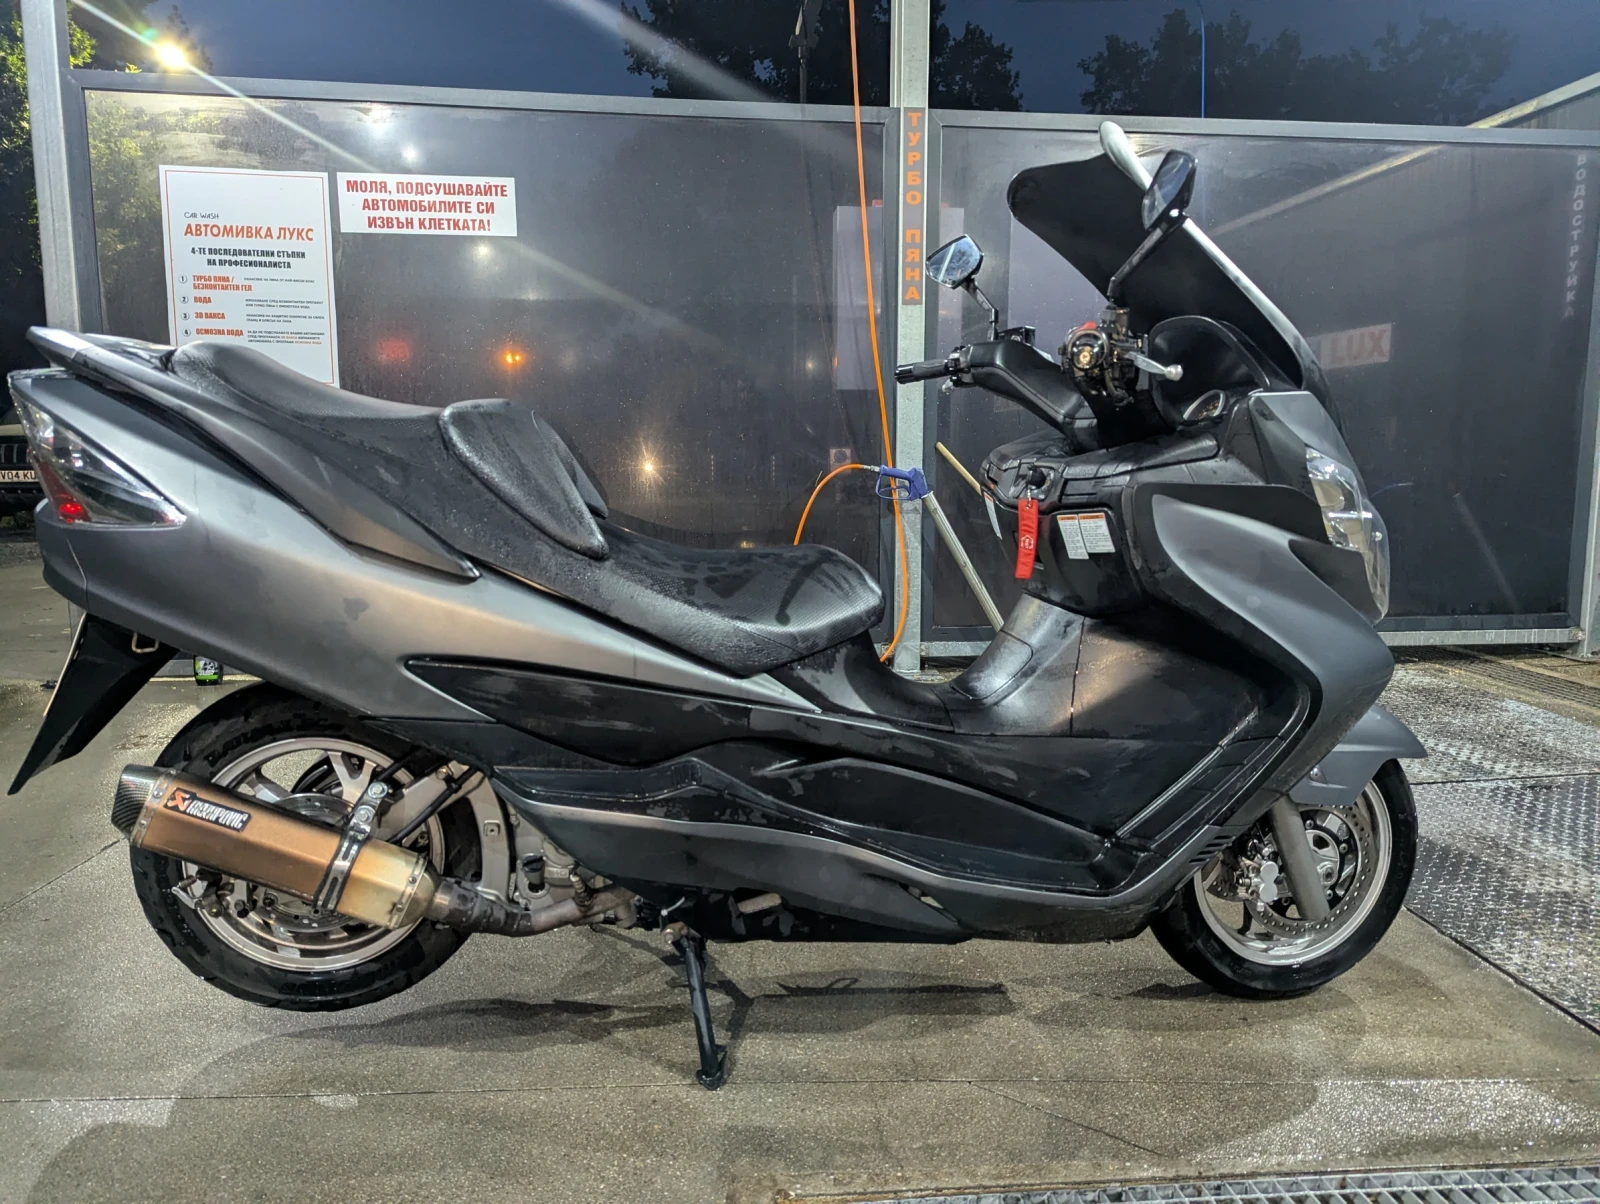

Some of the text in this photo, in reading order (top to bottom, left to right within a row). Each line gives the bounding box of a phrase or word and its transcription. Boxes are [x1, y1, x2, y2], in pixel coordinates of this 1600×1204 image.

[346, 179, 508, 197] МОЛЯ, ПОДСУШАВАЙТЕ
[362, 198, 495, 215] АВТОМОБИЛИТЕ СИ
[904, 111, 923, 300] ТУРБО ПЯНА
[184, 211, 220, 220] CAR WASH
[367, 216, 491, 232] ИЗВЪН КЛЕТКАТА!
[183, 223, 314, 242] АВТОМИВКА ЛУКС
[190, 246, 306, 259] 4-ТЕ ПОСЛЕДОВАТЕЛНИ СТЪПКИ
[207, 258, 292, 269] НА ПРОФЕСИОНАЛИСТА
[192, 274, 213, 283] ТУРБО
[213, 275, 231, 283] ПЯНА
[193, 283, 253, 292] БЕЗКОНТАКТЕН ГЕЛ
[193, 296, 212, 304] ВОДА
[204, 312, 226, 320] ВАКСА
[195, 328, 244, 337] ОСМОЗНА ВОДА
[1330, 328, 1387, 365] LUX
